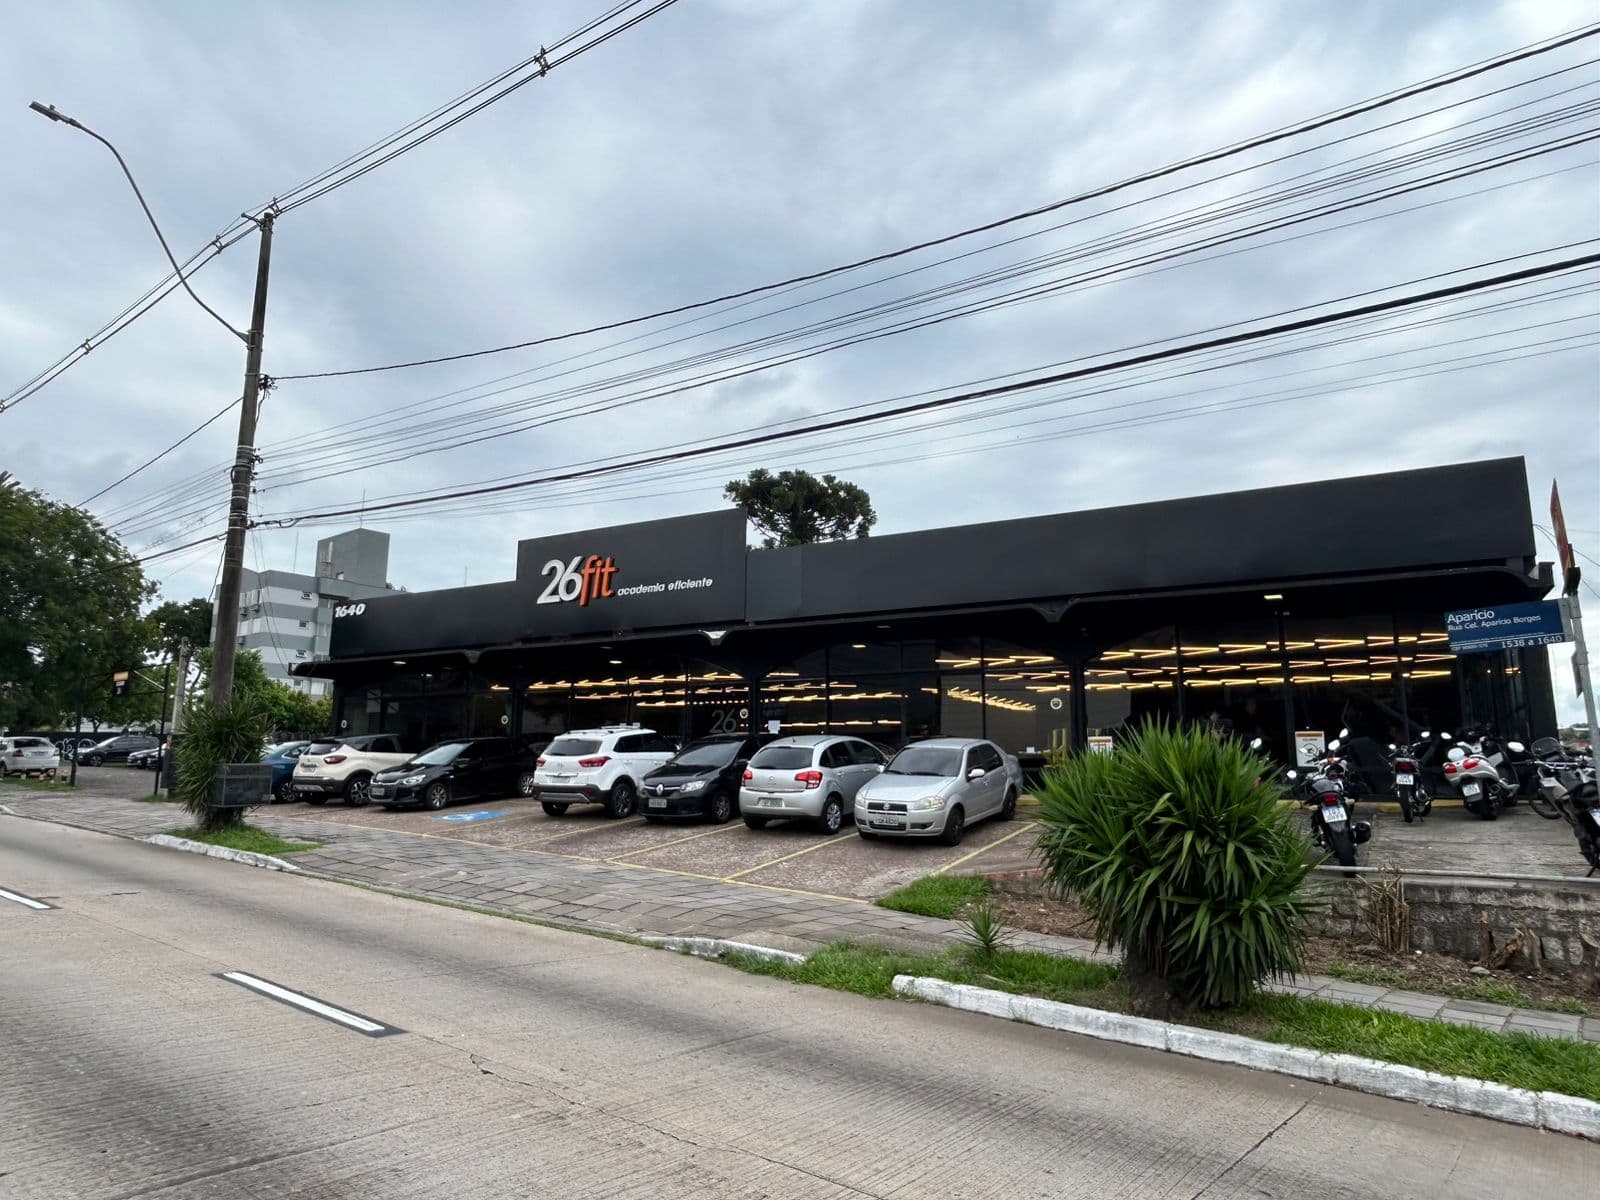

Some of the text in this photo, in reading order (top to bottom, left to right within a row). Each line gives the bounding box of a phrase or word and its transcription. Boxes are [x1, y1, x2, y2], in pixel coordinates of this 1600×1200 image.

[536, 554, 620, 607] 26fit
[617, 577, 713, 597] academia eficiente
[335, 603, 366, 618] 1640
[1513, 615, 1542, 624] Borges
[1538, 635, 1562, 645] 1640
[709, 708, 737, 733] 26
